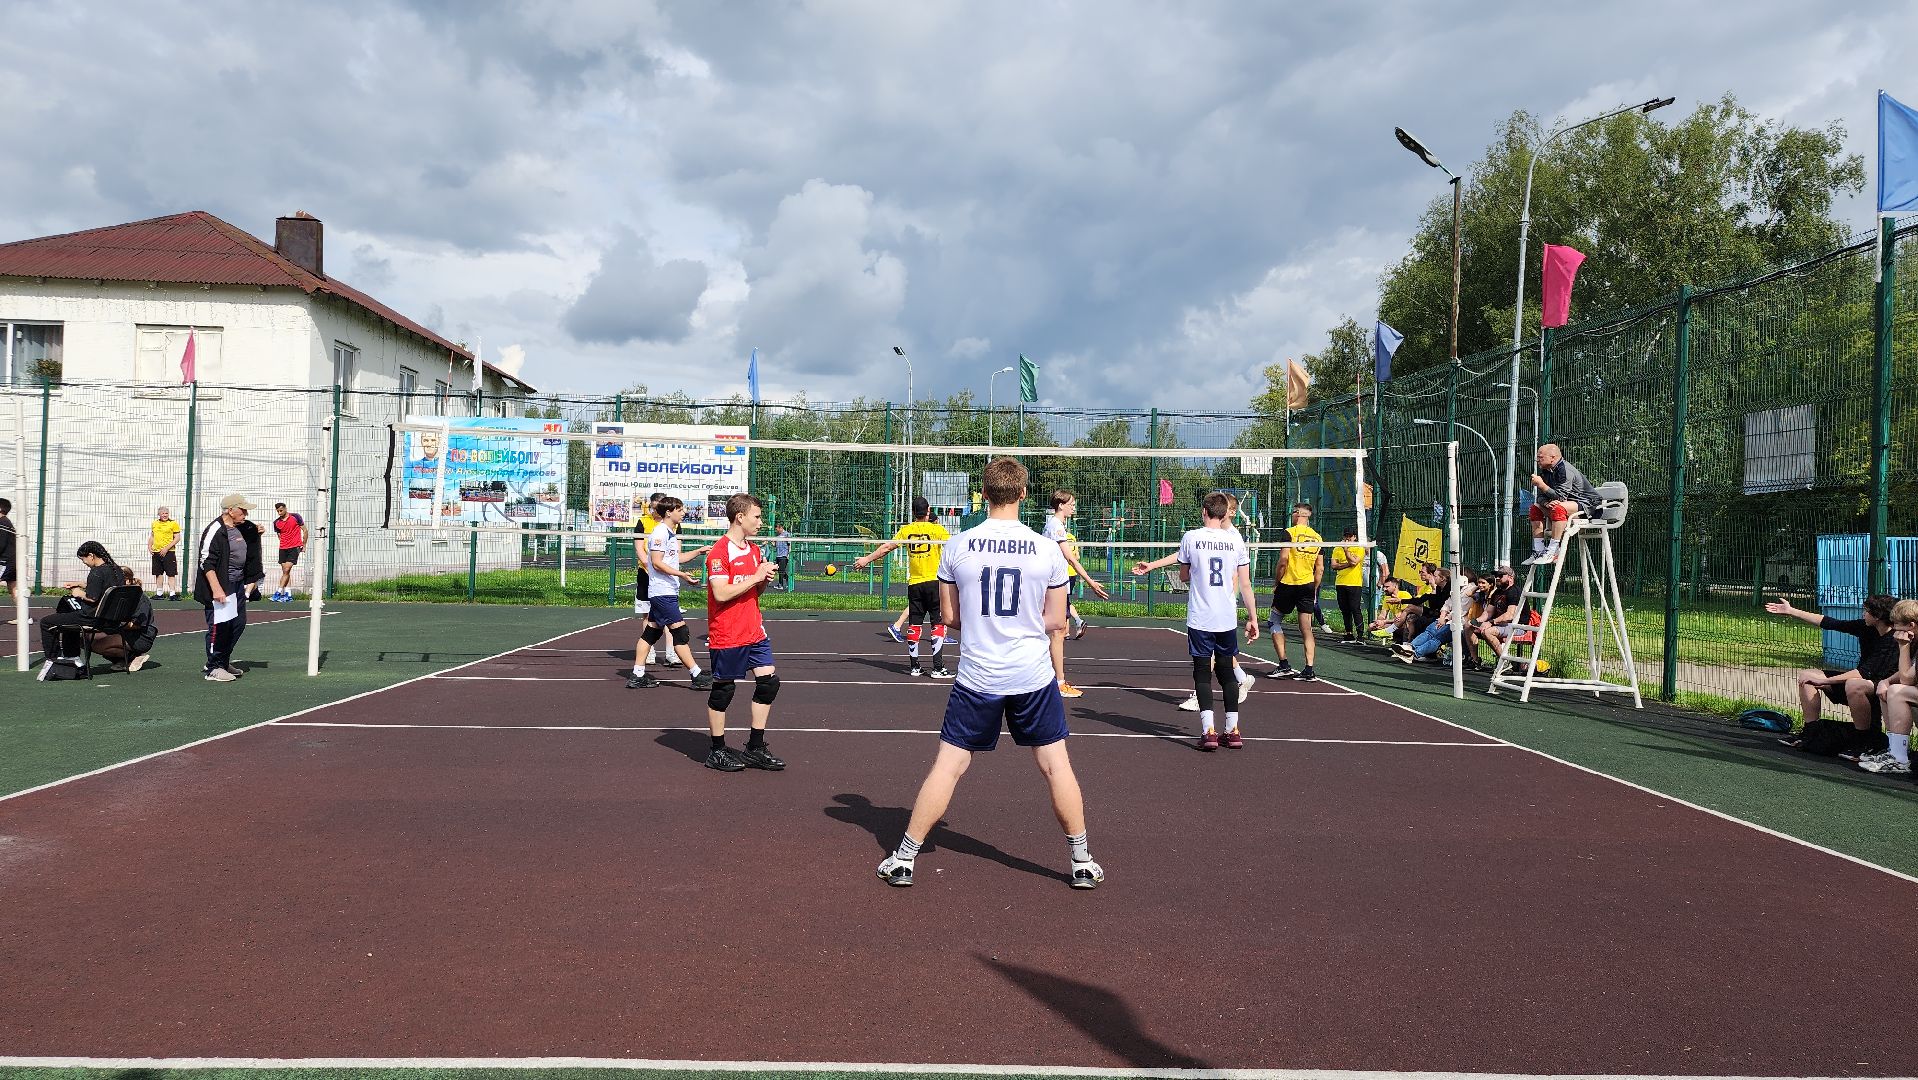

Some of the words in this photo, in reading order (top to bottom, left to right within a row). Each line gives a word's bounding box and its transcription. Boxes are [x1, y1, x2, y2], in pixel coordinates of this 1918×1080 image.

[471, 448, 540, 465] ВОЛЕЙБОЛУ
[608, 461, 631, 472] ПО
[637, 461, 733, 475] ВОЛЕЙБОЛУ
[968, 538, 1037, 555] КУПАВНА
[1195, 540, 1235, 551] КУПАВНА
[1209, 556, 1224, 587] 8
[978, 565, 1022, 617] 10
